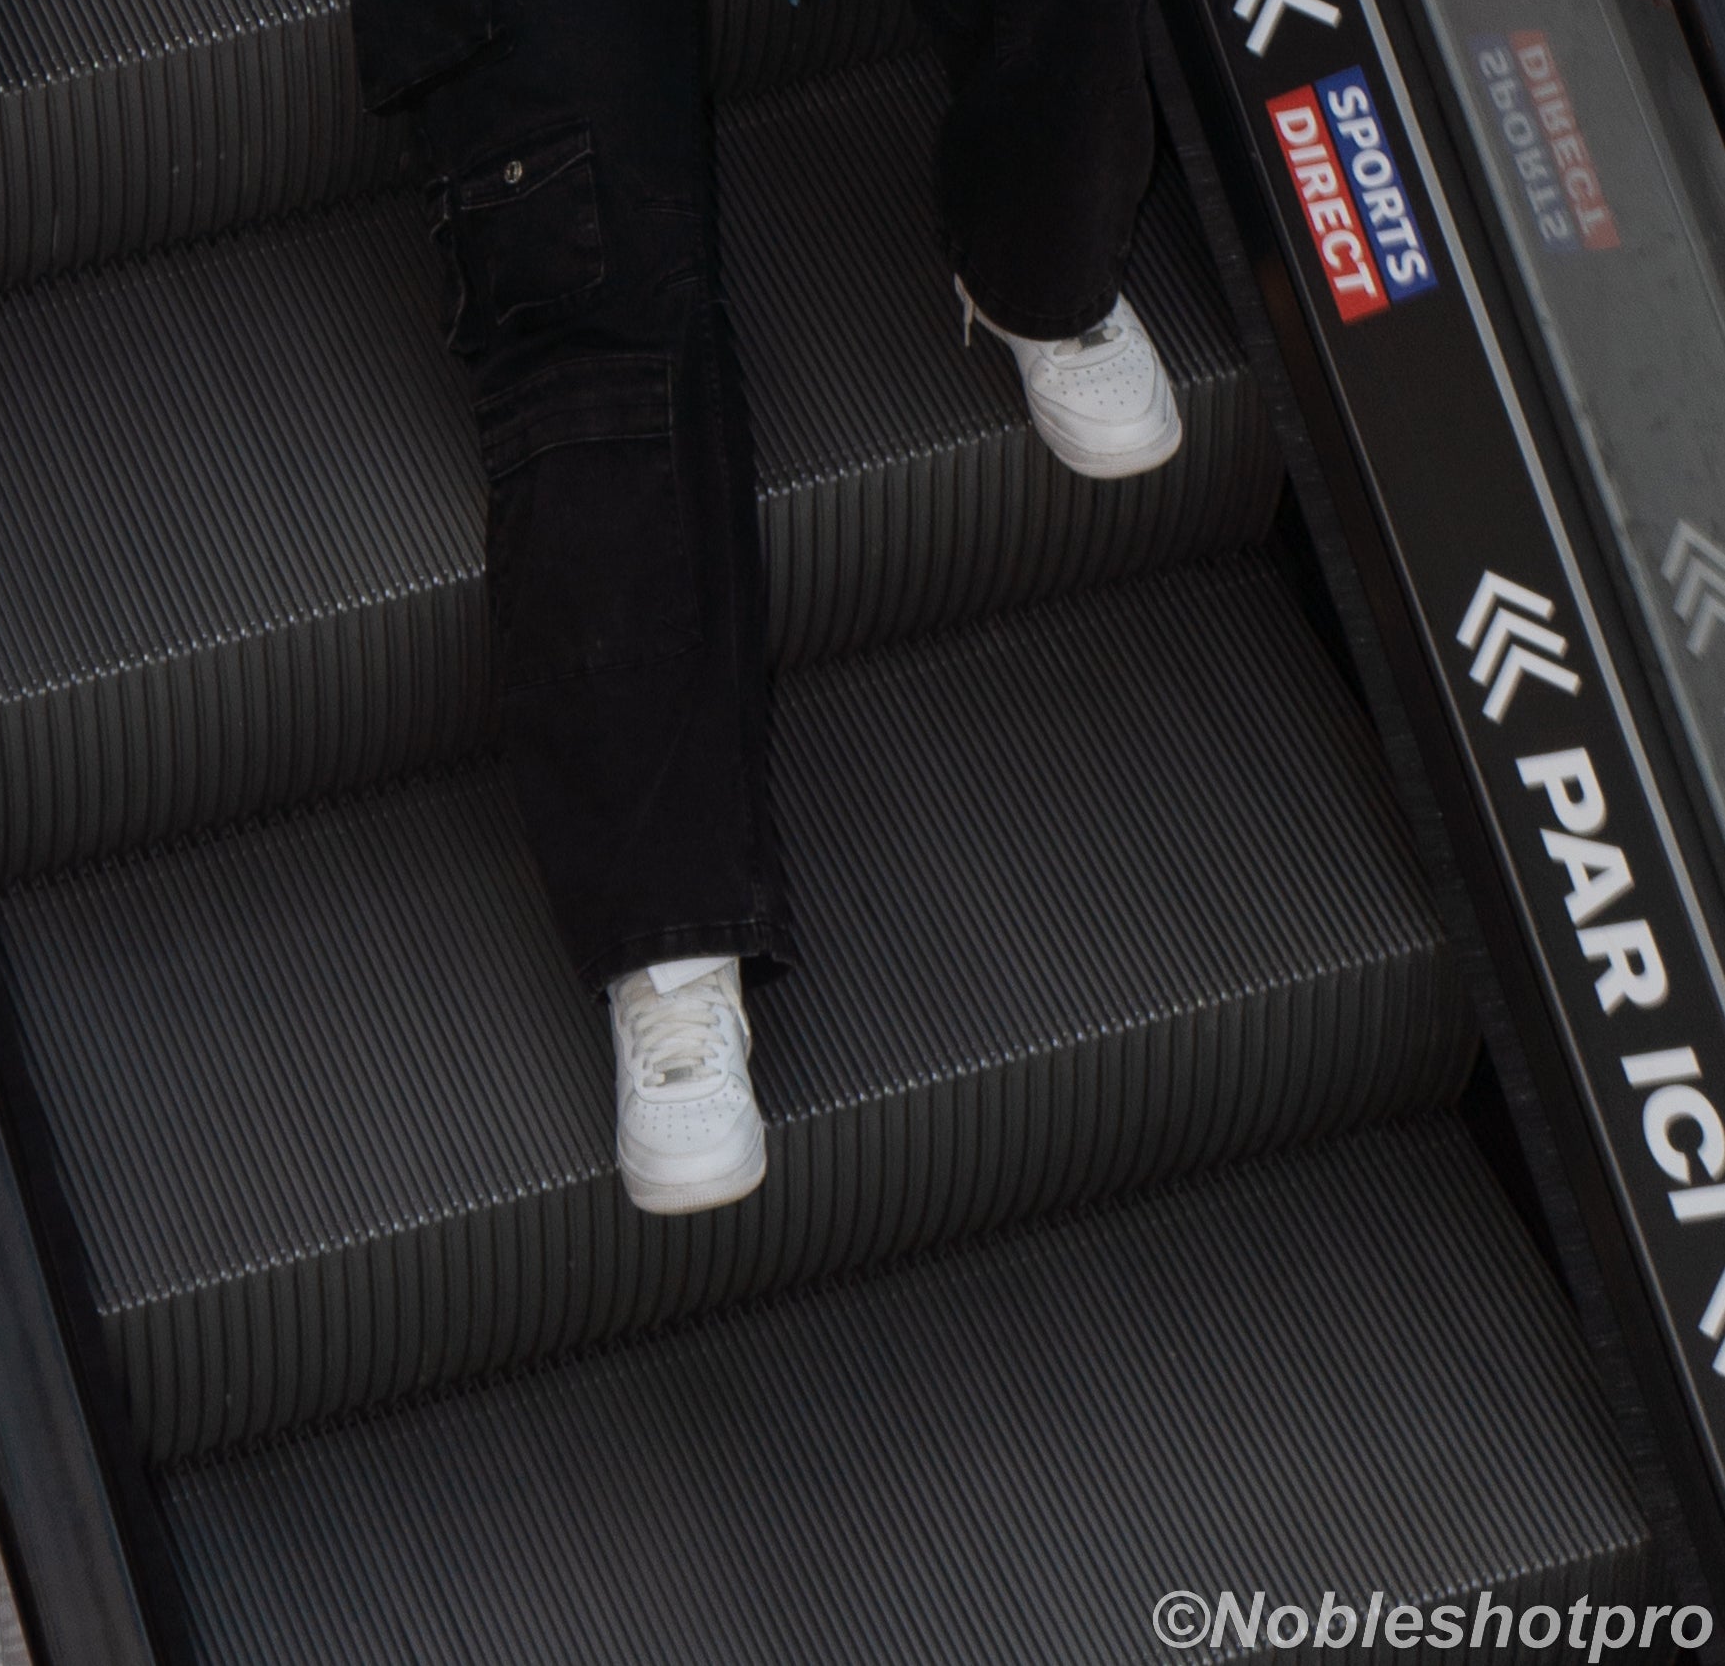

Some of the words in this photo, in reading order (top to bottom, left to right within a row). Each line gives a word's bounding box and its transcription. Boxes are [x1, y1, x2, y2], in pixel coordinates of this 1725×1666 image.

[1275, 106, 1376, 299] DIRECT
[1328, 84, 1428, 284] SPORTS
[1516, 747, 1670, 1015] PAR
[1621, 1046, 1725, 1226] ICI
